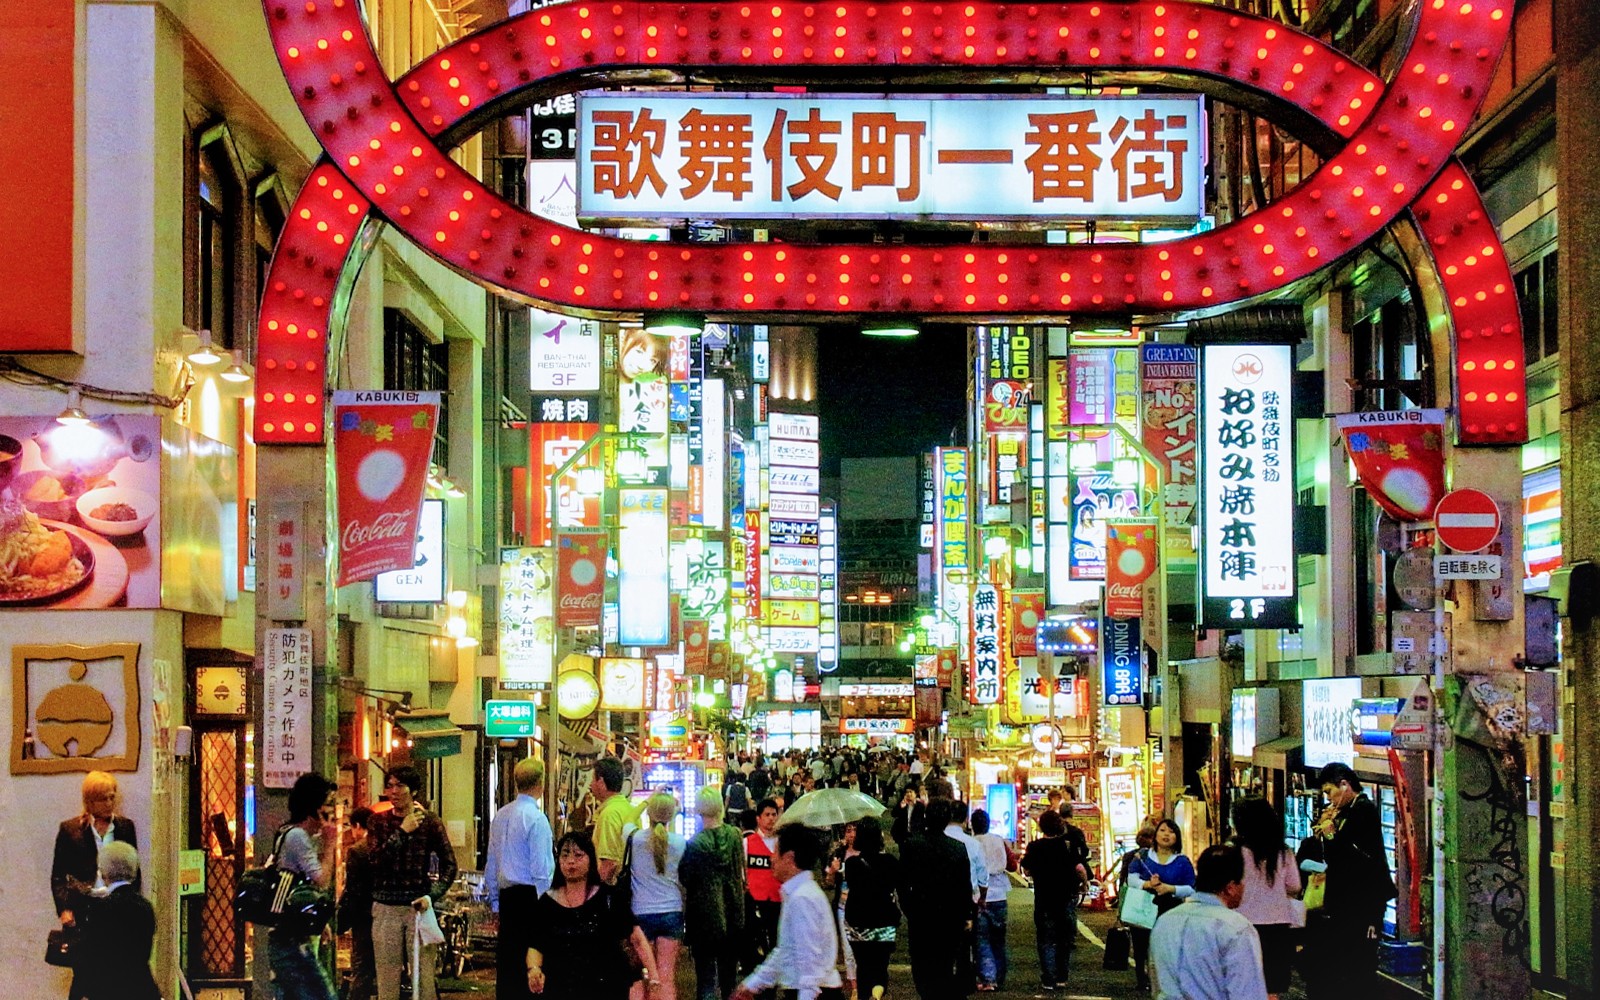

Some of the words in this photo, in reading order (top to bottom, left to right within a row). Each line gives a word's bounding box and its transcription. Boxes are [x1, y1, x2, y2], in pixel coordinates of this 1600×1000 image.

[590, 107, 1188, 203] 歌舞伎町一番街
[552, 373, 577, 386] 3F
[355, 392, 419, 403] KABUKI町
[542, 398, 589, 422] 焼肉
[1359, 411, 1423, 423] KABUKI町
[776, 425, 811, 436] HUMAX
[944, 451, 966, 567] まんが喫茶
[1438, 561, 1497, 574] 自転車を除く
[396, 575, 423, 585] GEN
[1230, 598, 1265, 619] 2F
[975, 590, 997, 699] 無料案内所
[1114, 622, 1130, 667] DINING
[1114, 669, 1131, 695] BAR
[281, 633, 297, 766] 防犯カメラ作動中
[490, 705, 531, 718] 大塚歯科
[518, 724, 529, 733] 4F
